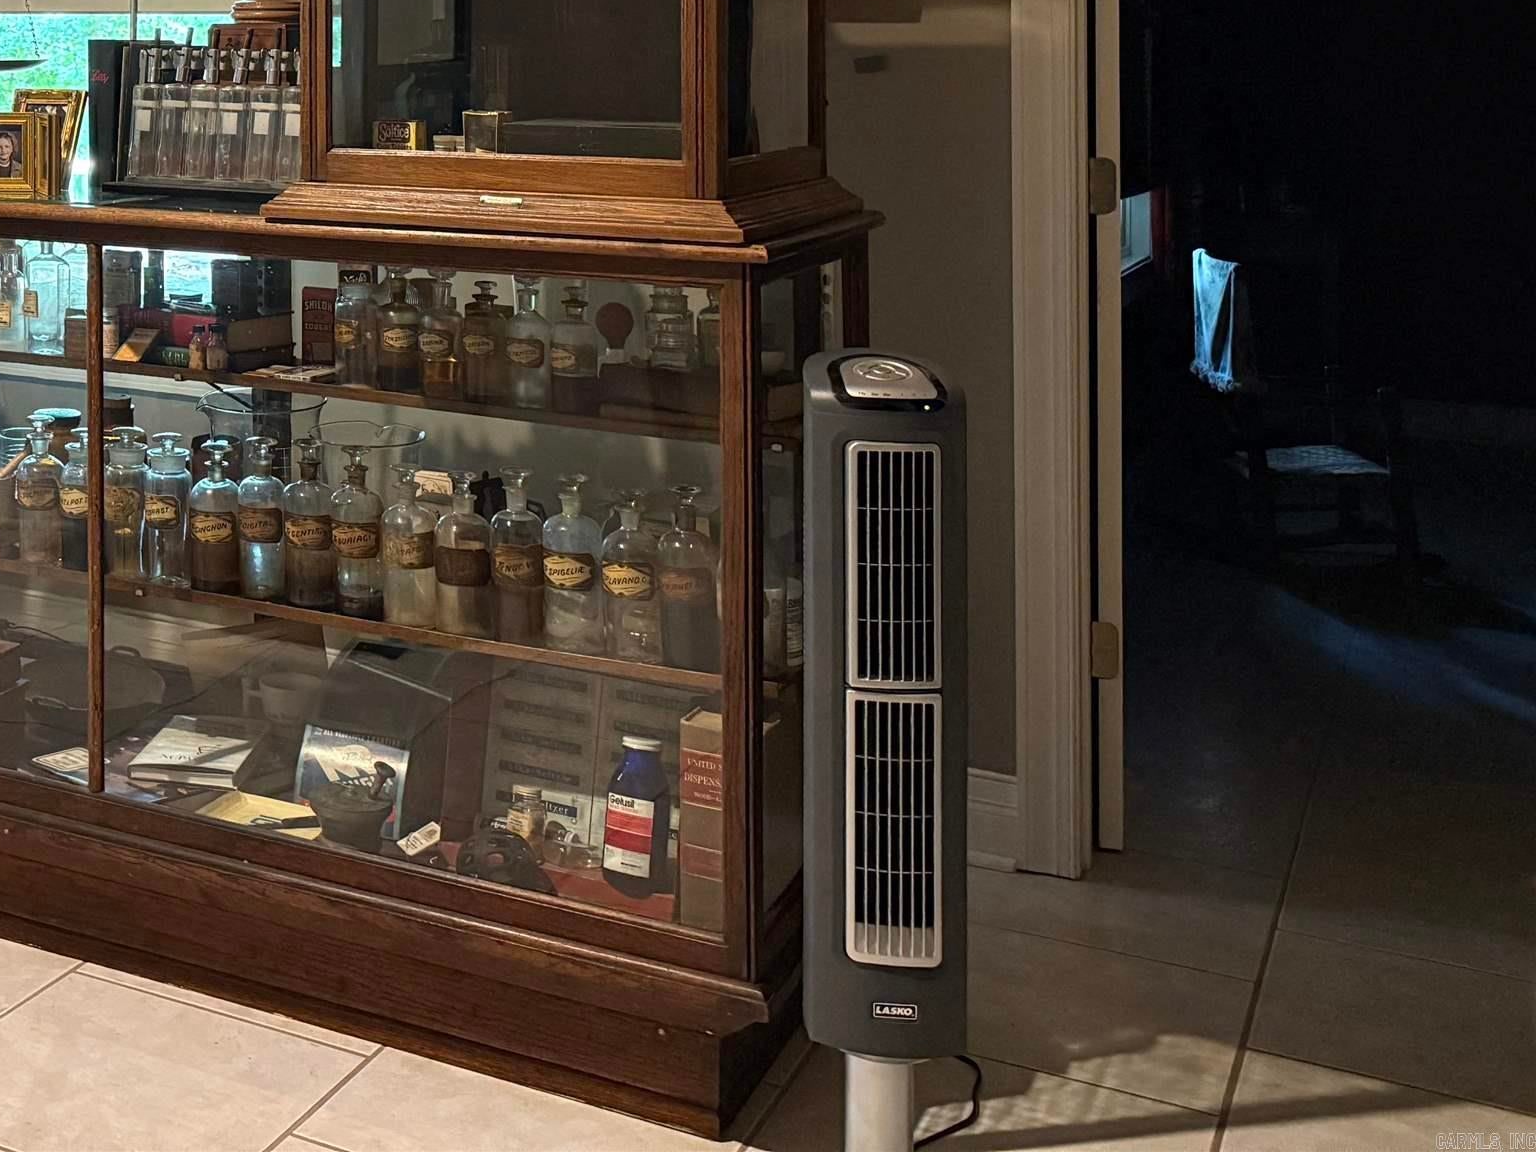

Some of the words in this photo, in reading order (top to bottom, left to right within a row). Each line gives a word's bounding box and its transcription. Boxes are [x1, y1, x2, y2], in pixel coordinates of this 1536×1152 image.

[687, 757, 712, 770] UNITED
[683, 772, 722, 787] DISPENS
[609, 794, 635, 809] Gelusil
[875, 1005, 913, 1017] LASKO
